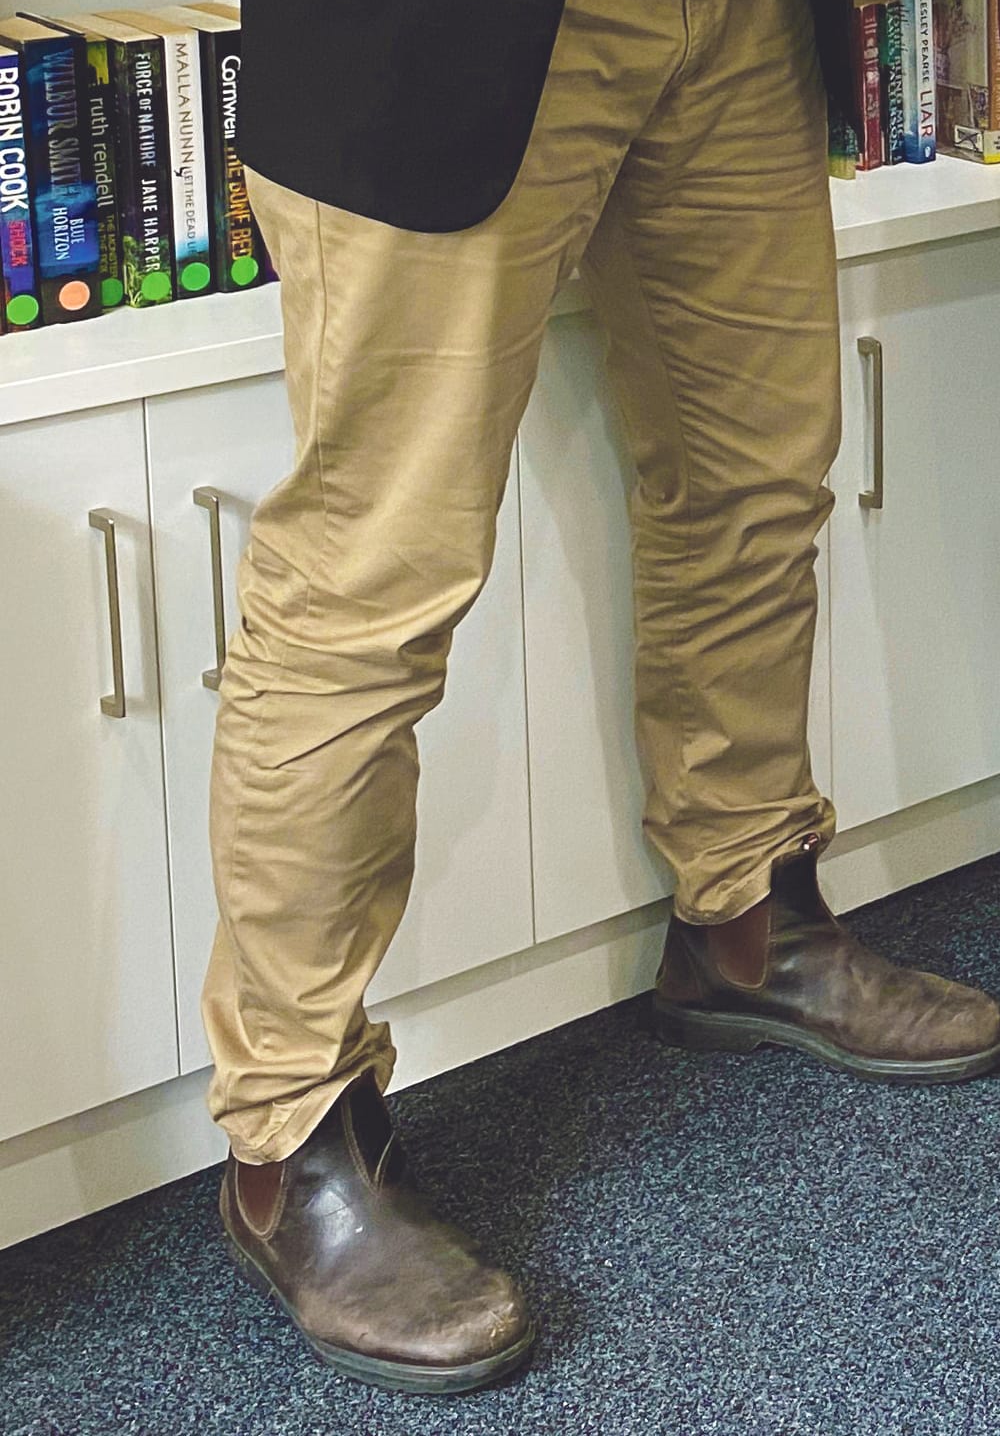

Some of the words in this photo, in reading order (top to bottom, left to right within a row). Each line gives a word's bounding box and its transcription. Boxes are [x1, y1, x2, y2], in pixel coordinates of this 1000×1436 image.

[135, 52, 153, 97] FORCE
[175, 42, 190, 109] MALLA
[920, 38, 930, 84] PEARSE
[0, 64, 22, 143] ROBIN
[42, 47, 77, 136] WILBUR
[89, 97, 109, 137] ruth
[138, 98, 152, 112] OF
[221, 54, 242, 140] Cornwell
[919, 89, 934, 139] LIAR
[138, 113, 157, 168] NATURE
[178, 111, 194, 165] NUNN
[0, 147, 29, 214] COOK
[50, 138, 82, 197] SMITH
[92, 142, 115, 209] rendell
[141, 179, 158, 213] JANE
[185, 191, 195, 209] THE
[8, 220, 28, 268] SHOCK
[52, 207, 71, 262] HORIZON
[70, 217, 85, 245] BLUE
[143, 218, 161, 273] HARPER
[185, 211, 197, 241] DEAD
[230, 227, 253, 261] BED
